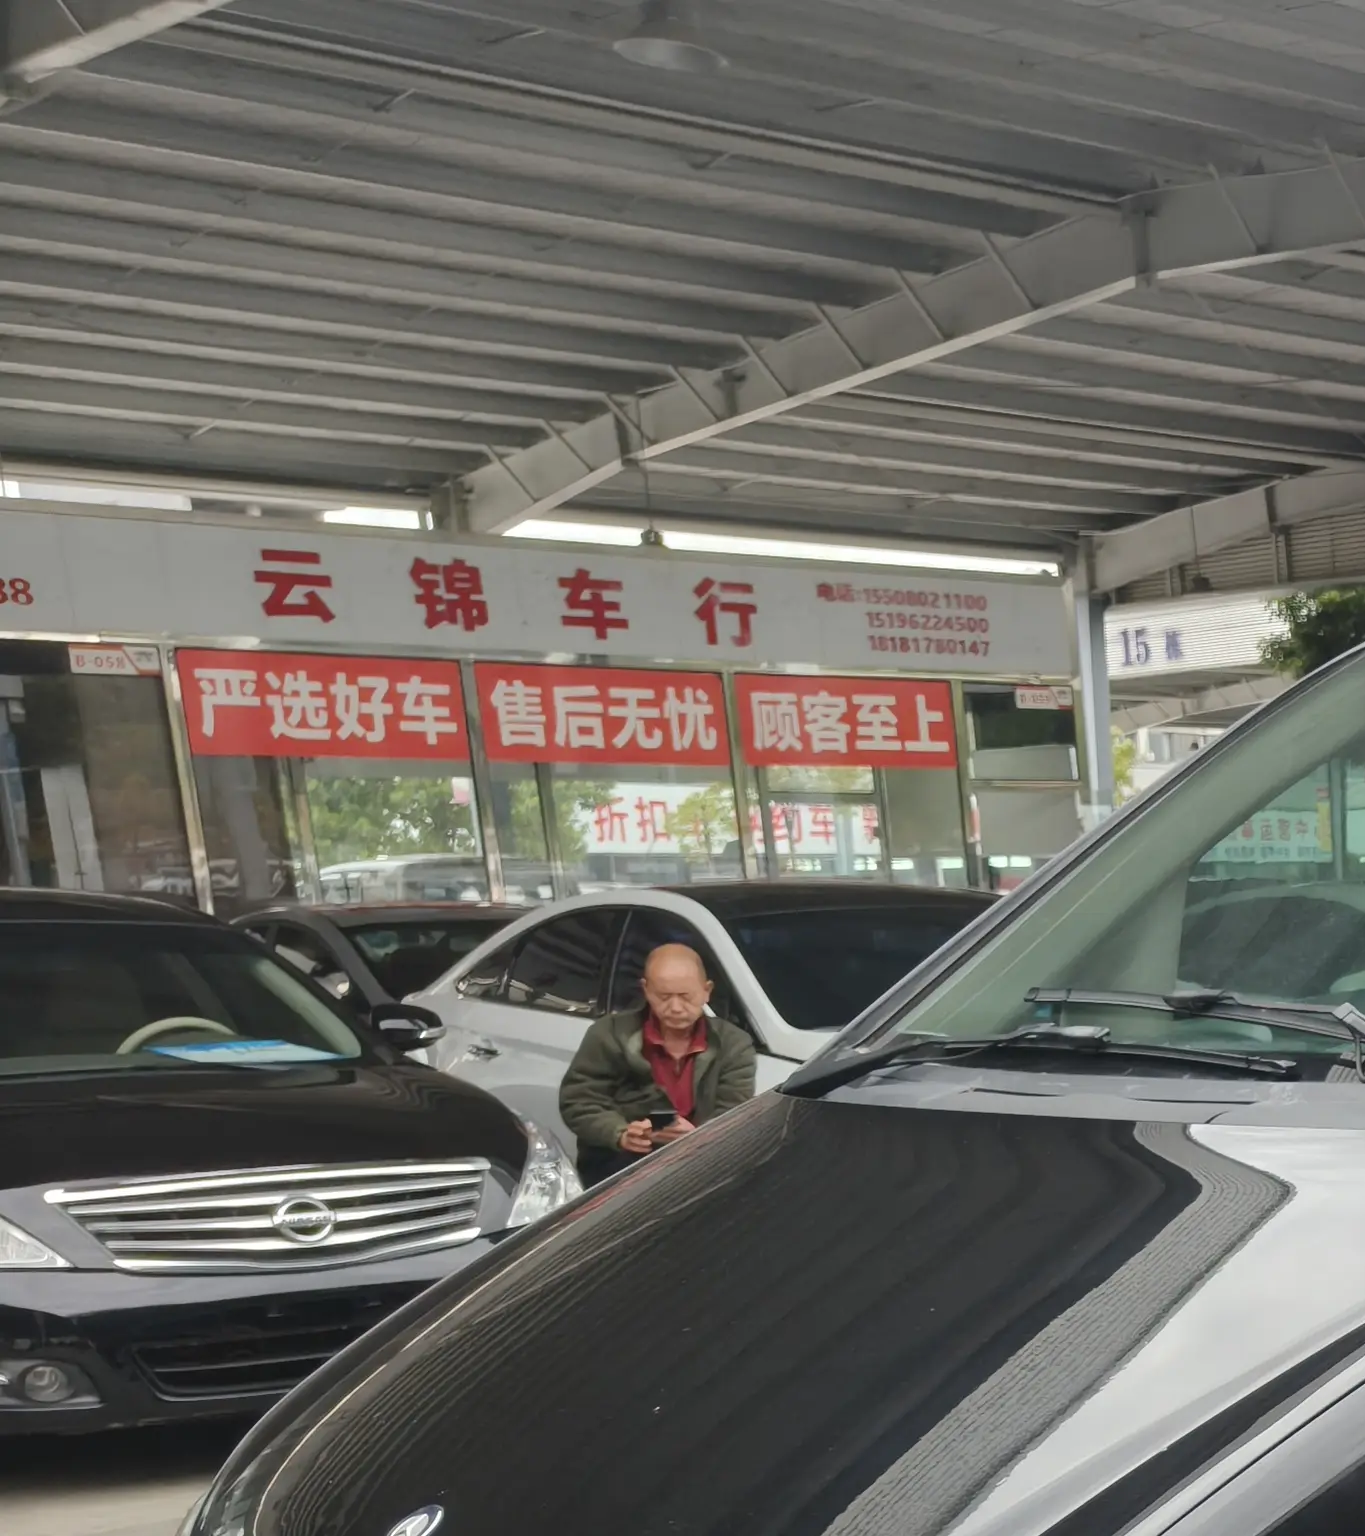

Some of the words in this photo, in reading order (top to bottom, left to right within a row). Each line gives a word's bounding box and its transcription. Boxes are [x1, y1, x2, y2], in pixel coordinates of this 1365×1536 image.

[253, 548, 758, 647] 云锦车行
[194, 667, 458, 745] 严选好车
[490, 678, 718, 752] 售后无忧
[749, 691, 951, 755] 顾客至上
